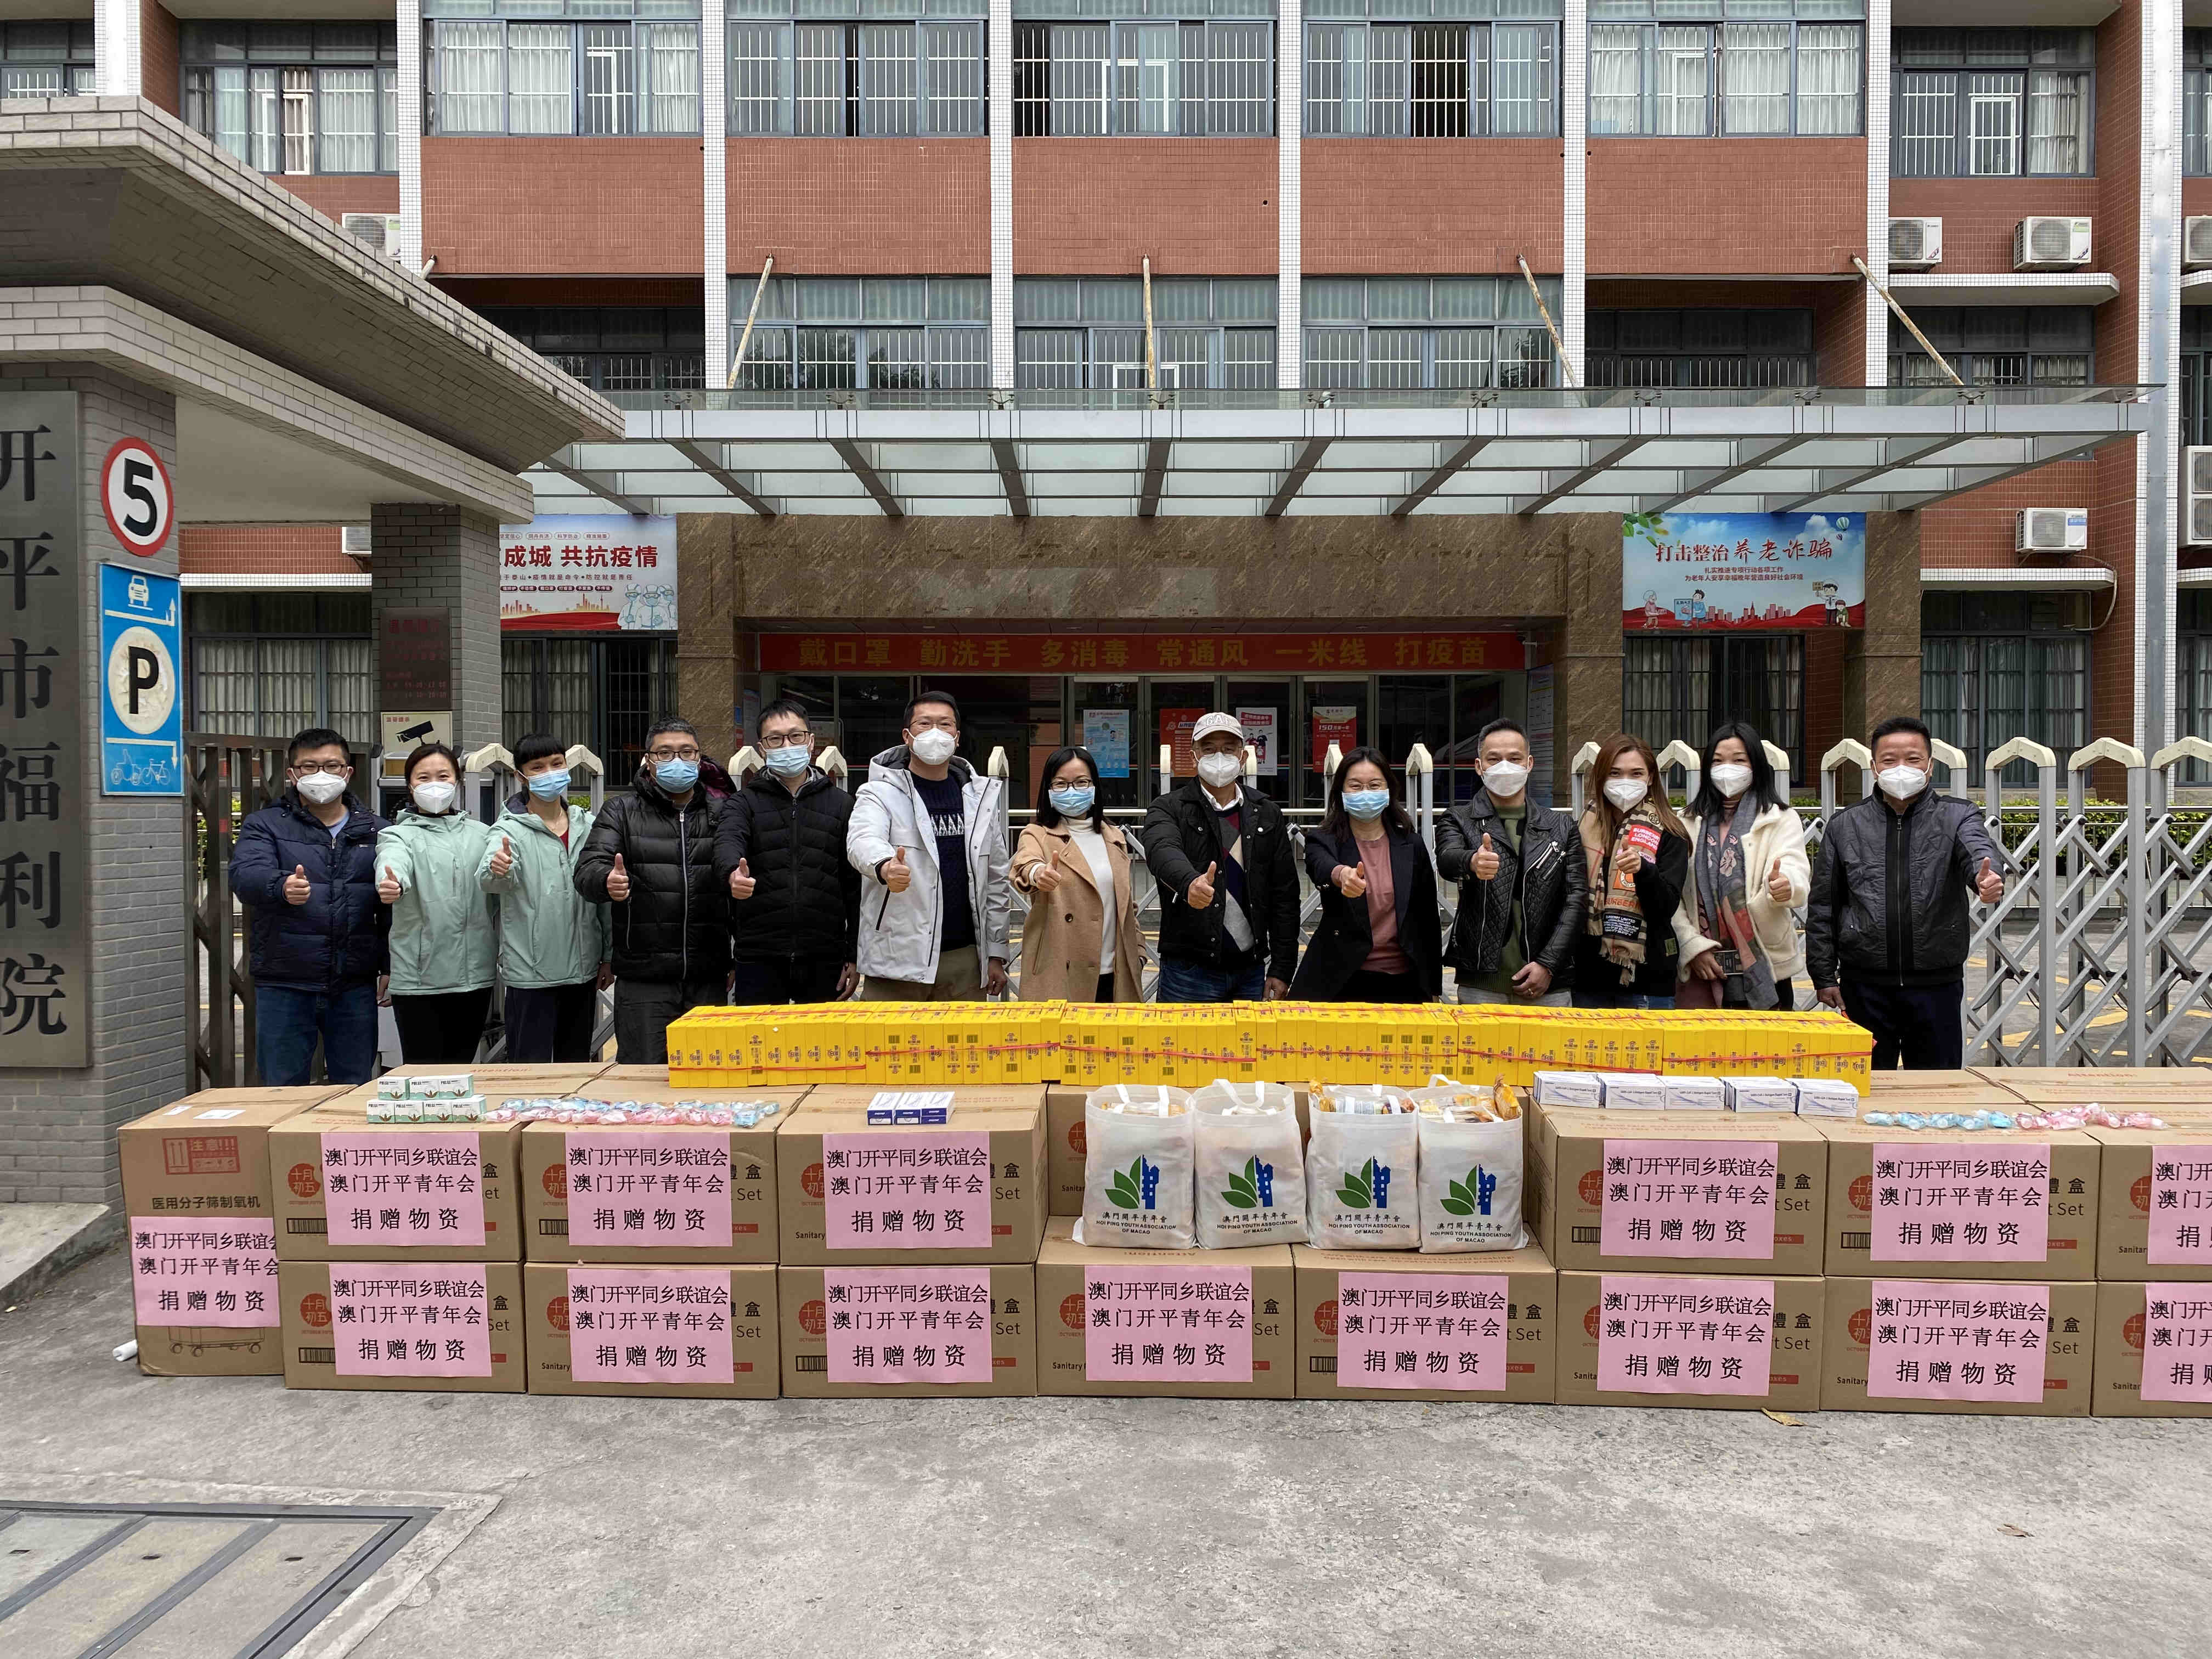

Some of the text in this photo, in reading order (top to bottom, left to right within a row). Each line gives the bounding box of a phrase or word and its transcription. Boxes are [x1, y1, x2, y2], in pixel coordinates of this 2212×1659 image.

[123, 458, 158, 537] 5
[500, 545, 658, 567] 成城 共抗疫情
[128, 646, 160, 714] P
[0, 424, 67, 1035] 开平市福利院
[325, 1148, 478, 1166] 澳门开平同乡联谊会
[569, 1148, 728, 1167] 澳门开平同乡联谊会
[827, 1147, 988, 1168] 澳门开平同乡联谊会
[1607, 1156, 1775, 1178] 澳门开平同乡联谊会
[1876, 1159, 2047, 1179] 澳门开平同乡联谊会
[2155, 1162, 2212, 1181] 澳门开
[330, 1174, 476, 1193] 澳门开平青年会
[482, 1187, 499, 1199] et
[573, 1174, 724, 1194] 澳门开平青年会
[831, 1173, 984, 1195] 澳门开平青年会
[996, 1187, 1020, 1200] Set
[152, 1196, 260, 1209] 医用分子筛制氧机
[737, 1188, 763, 1201] Set
[1609, 1183, 1770, 1205] 澳门开平青年会
[1785, 1197, 1810, 1211] Set
[1880, 1187, 2042, 1207] 澳门开平青年会
[351, 1208, 459, 1231] 捐赠物资
[594, 1208, 705, 1231] 捐赠物资
[2058, 1203, 2084, 1216] Set
[851, 1209, 965, 1233] 捐赠物资
[1628, 1219, 1747, 1243] 捐赠物资
[1899, 1222, 2020, 1245] 捐赠物资
[2119, 1245, 2147, 1254] Sanitar
[334, 1280, 484, 1298] 澳门开平同乡联谊会
[572, 1285, 728, 1305] 澳门开平同乡联谊会
[828, 1284, 988, 1304] 澳门开平同乡联谊会
[1088, 1282, 1249, 1301] 澳门开平同乡联谊会
[159, 1290, 264, 1312] 捐赠物资
[1342, 1289, 1505, 1310] 澳门开平同乡联谊会
[1604, 1293, 1771, 1316] 澳门开平同乡联谊会
[1876, 1297, 2047, 1322] 澳门开平同乡联谊会
[338, 1306, 482, 1325] 澳门开平青年会
[576, 1311, 725, 1331] 澳门开平青年会
[833, 1311, 984, 1330] 澳门开平青年会
[1092, 1308, 1245, 1329] 澳门开平青年会
[736, 1325, 761, 1338] Set
[996, 1323, 1020, 1335] Set
[1254, 1323, 1279, 1336] Set
[1345, 1315, 1500, 1338] 澳门开平青年会
[1516, 1328, 1542, 1340] Set
[1606, 1319, 1765, 1343] 澳门开平青年会
[1878, 1325, 2040, 1348] 澳门开平青年会
[358, 1339, 465, 1361] 捐赠物资
[1785, 1337, 1810, 1350] Set
[2052, 1341, 2079, 1354] Set
[596, 1345, 707, 1367] 捐赠物资
[853, 1345, 966, 1367] 捐赠物资
[1112, 1343, 1226, 1366] 捐赠物资
[1364, 1350, 1480, 1374] 捐赠物资
[1625, 1355, 1743, 1379] 捐赠物资
[1896, 1359, 2017, 1386] 捐赠物资
[2113, 1381, 2141, 1390] Sanitar
